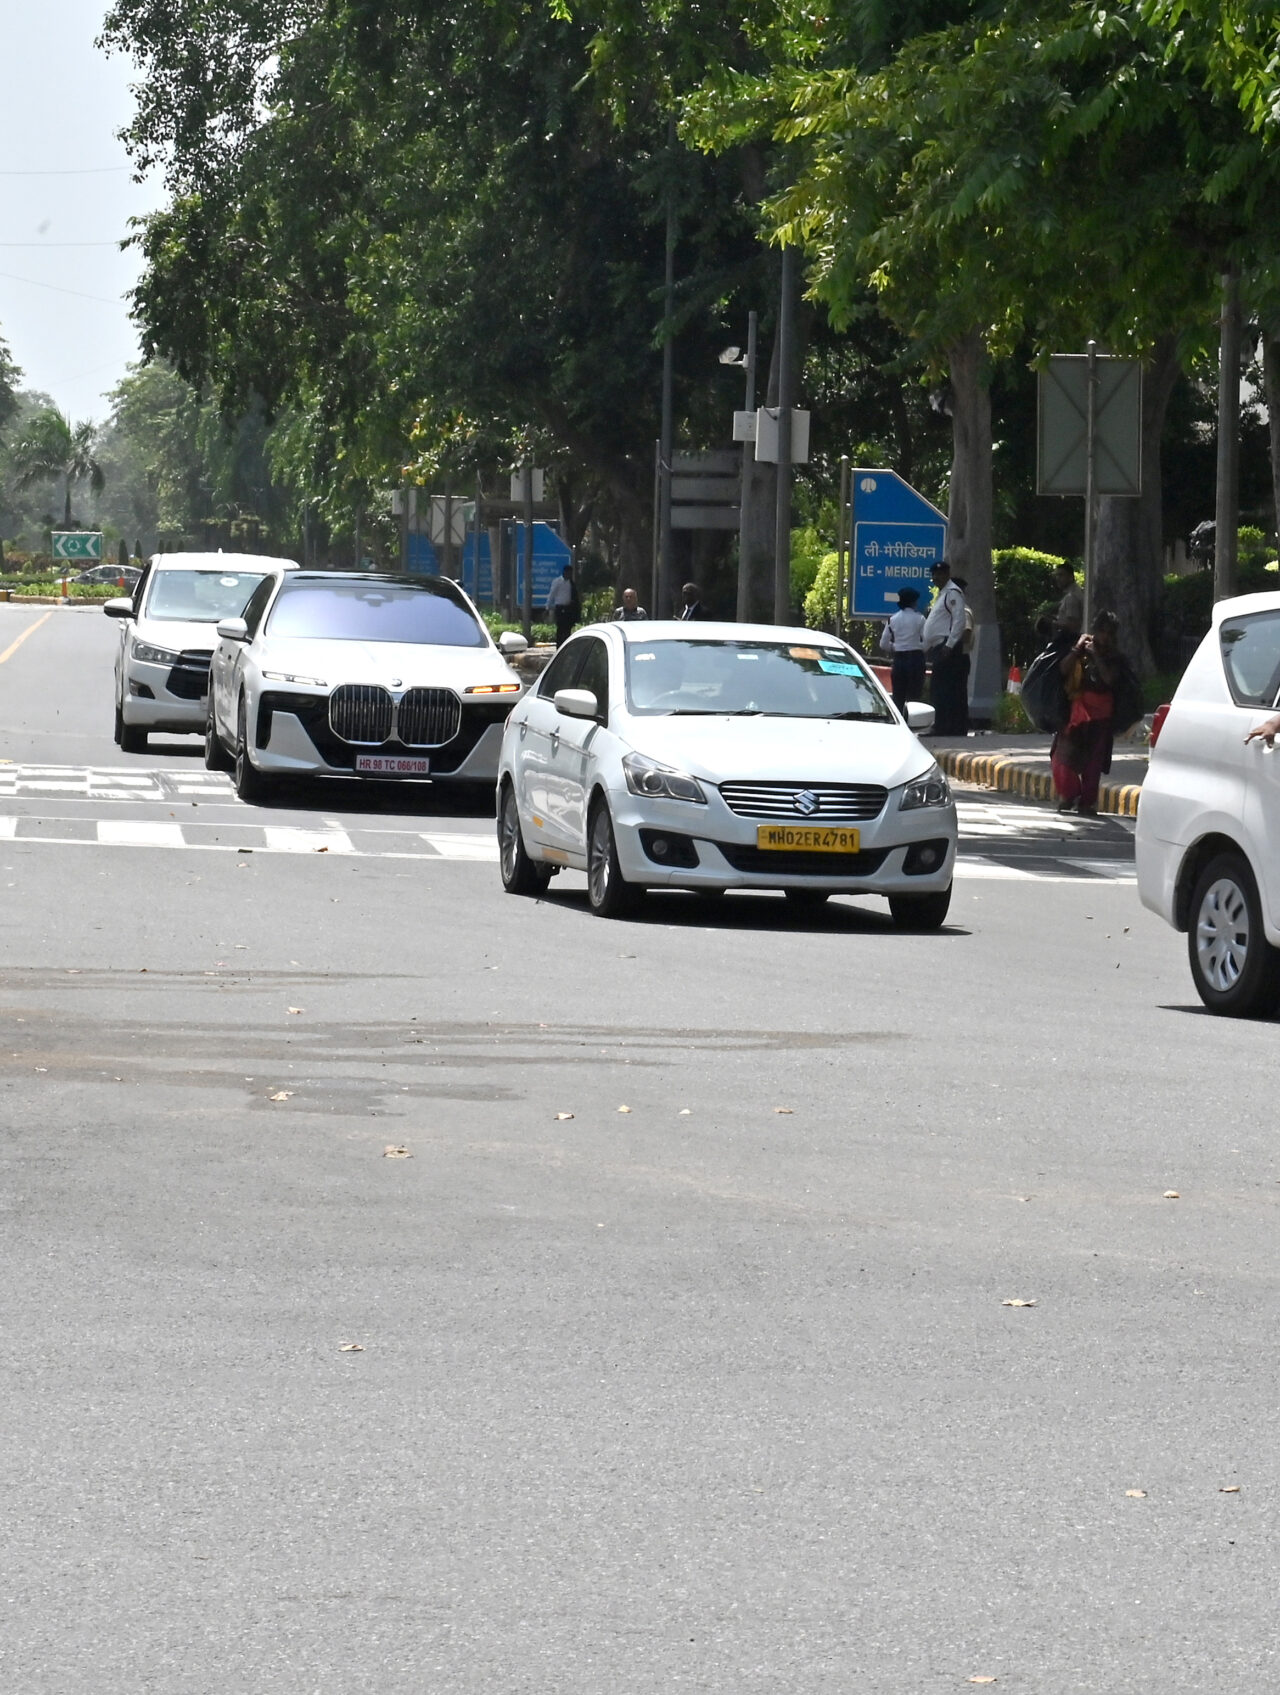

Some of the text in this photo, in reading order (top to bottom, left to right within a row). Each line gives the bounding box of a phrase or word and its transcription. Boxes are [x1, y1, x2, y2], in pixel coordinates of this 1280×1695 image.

[885, 566, 932, 578] MERIDIE
[360, 758, 371, 769] HR
[385, 760, 395, 770] TC
[769, 831, 855, 848] MH02ER4781
